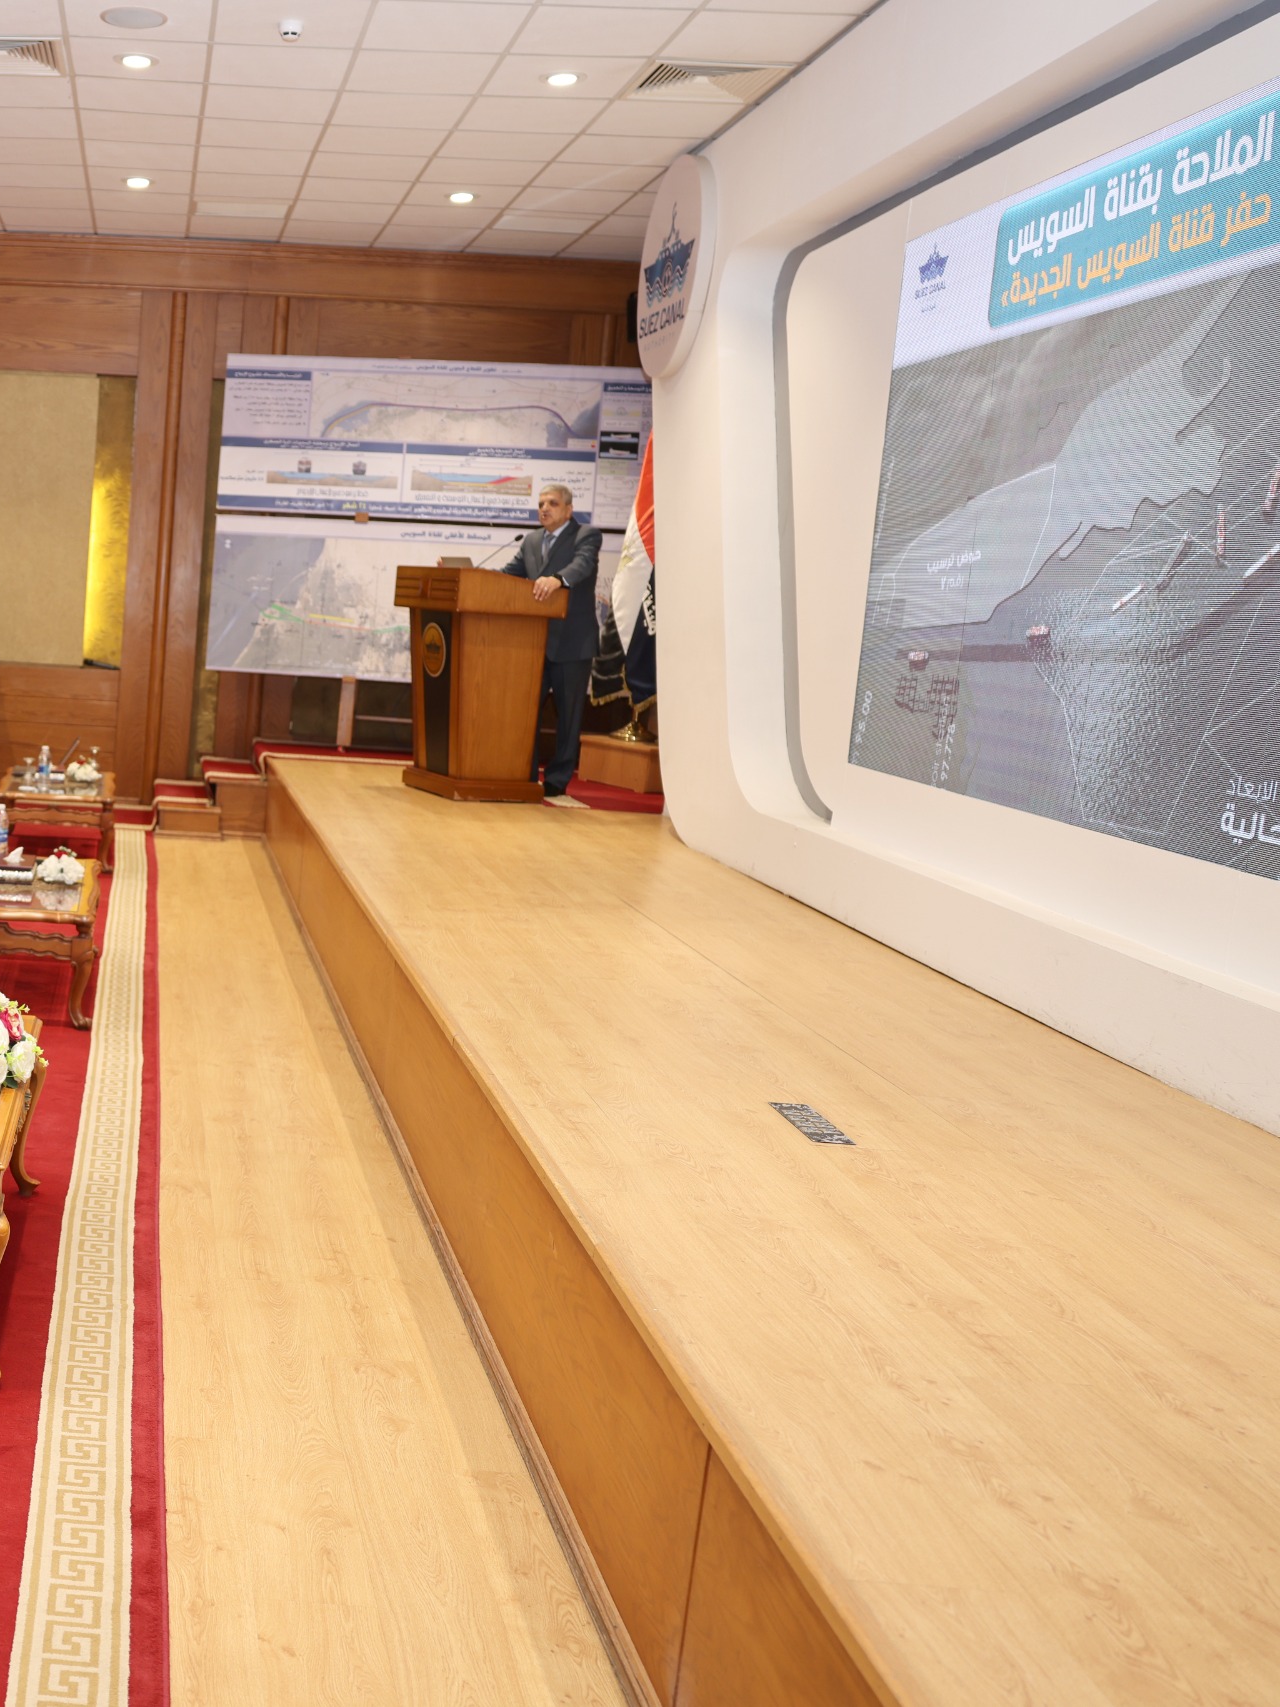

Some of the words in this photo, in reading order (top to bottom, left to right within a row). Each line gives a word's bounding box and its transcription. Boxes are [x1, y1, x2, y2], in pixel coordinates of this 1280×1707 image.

[1172, 110, 1276, 196] الملاحة
[1103, 162, 1163, 222] بقناة
[1220, 191, 1271, 247] حفر
[1007, 185, 1096, 266] السويس
[1076, 221, 1161, 290] السويس
[1168, 202, 1215, 253] قناة
[639, 311, 660, 339] SUEZ
[660, 297, 685, 330] CANAL
